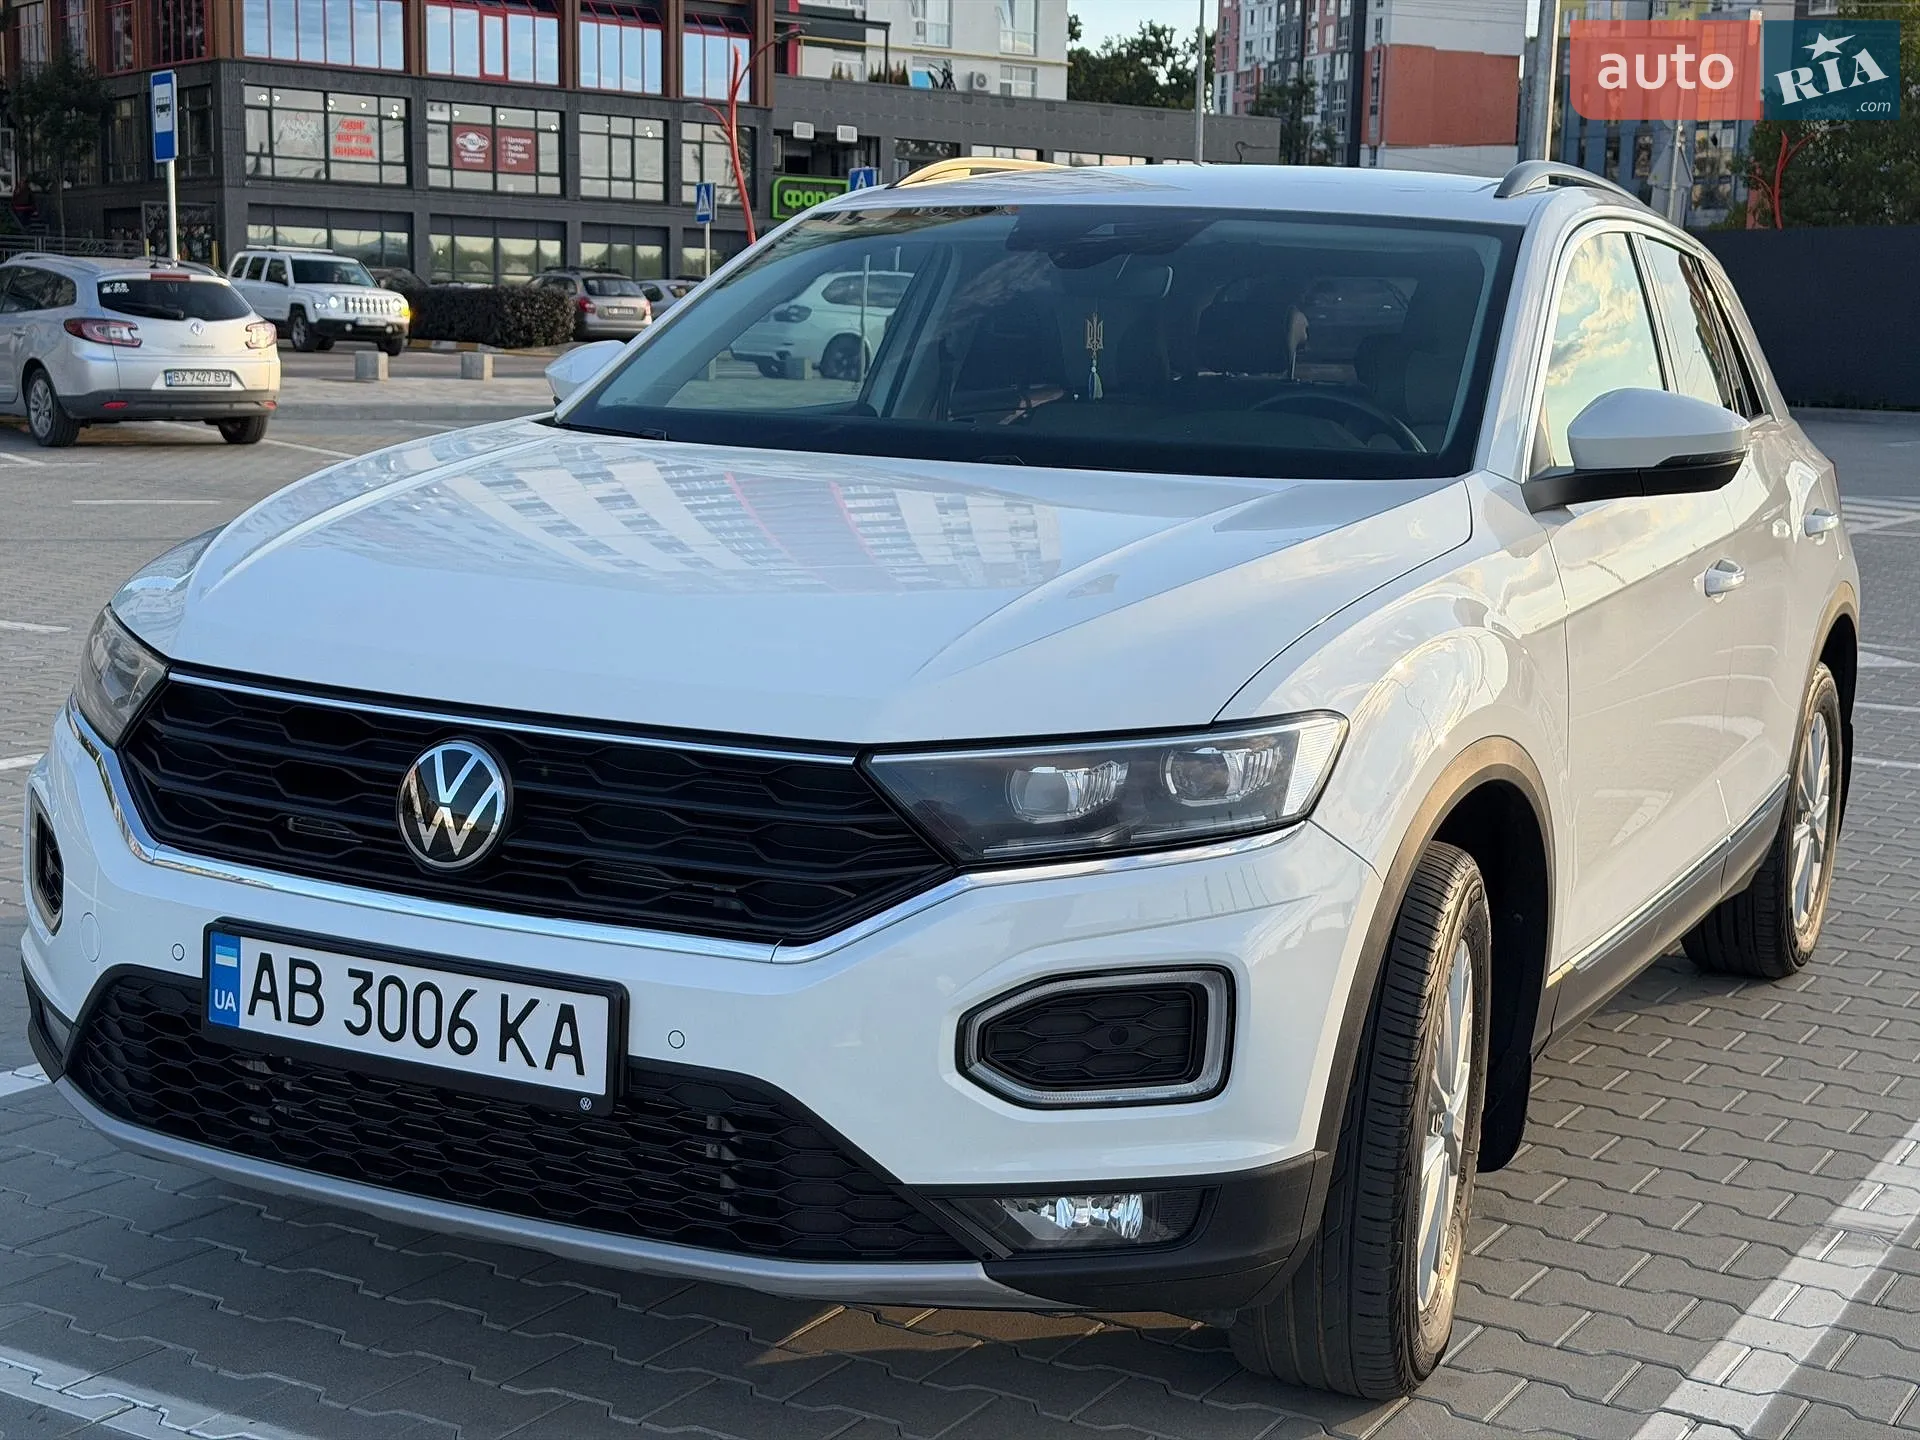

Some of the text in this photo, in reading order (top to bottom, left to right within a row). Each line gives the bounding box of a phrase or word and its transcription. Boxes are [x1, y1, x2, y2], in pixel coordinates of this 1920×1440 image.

[214, 988, 237, 1013] UA
[247, 951, 586, 1076] AB 3006 KA
